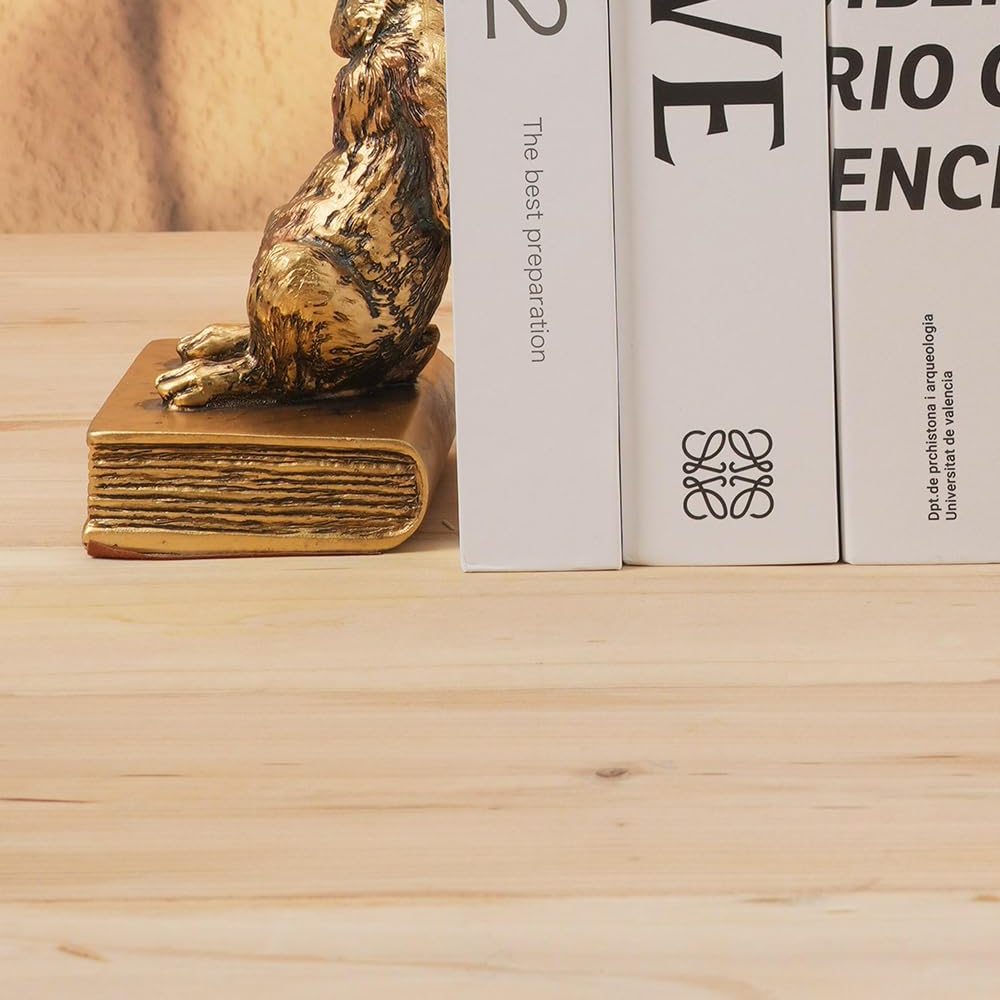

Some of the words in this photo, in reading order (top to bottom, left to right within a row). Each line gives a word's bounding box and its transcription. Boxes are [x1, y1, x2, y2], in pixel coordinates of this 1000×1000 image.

[523, 117, 543, 161] The
[524, 169, 544, 220] best
[522, 228, 550, 363] preparation
[922, 313, 938, 392] arqueologia
[941, 370, 955, 426] valencia
[925, 403, 941, 474] prchistona
[942, 429, 955, 446] de
[944, 449, 958, 521] Universitat
